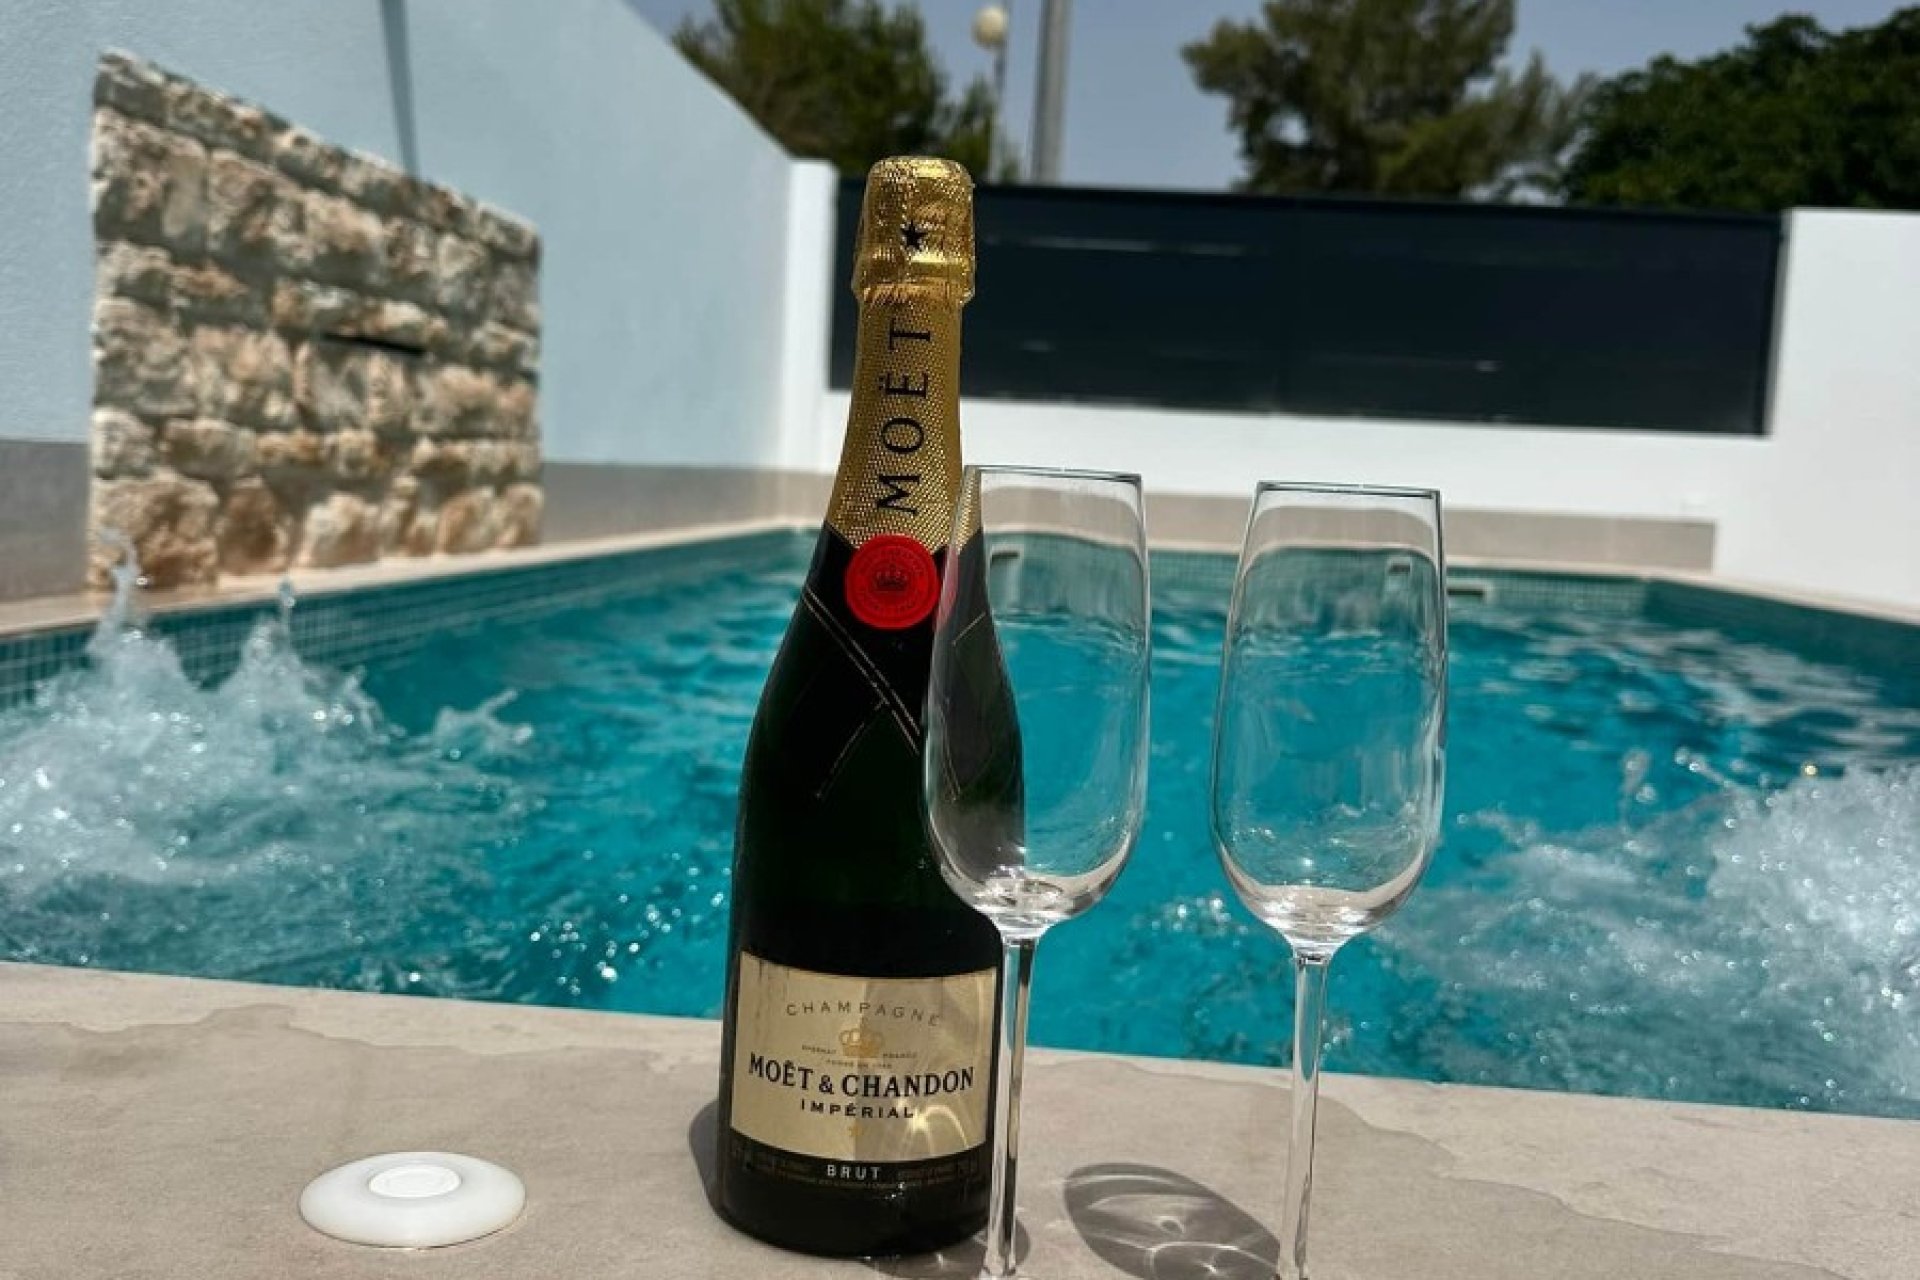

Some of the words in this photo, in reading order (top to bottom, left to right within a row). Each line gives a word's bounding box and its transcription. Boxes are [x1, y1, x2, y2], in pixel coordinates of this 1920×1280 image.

[877, 317, 931, 515] MOËT
[785, 1001, 941, 1027] CHAMPAGNE
[818, 1074, 835, 1095] &
[841, 1066, 975, 1098] CHANDON
[800, 1098, 914, 1119] IMPÉRIAL
[826, 1163, 881, 1181] BRUT
